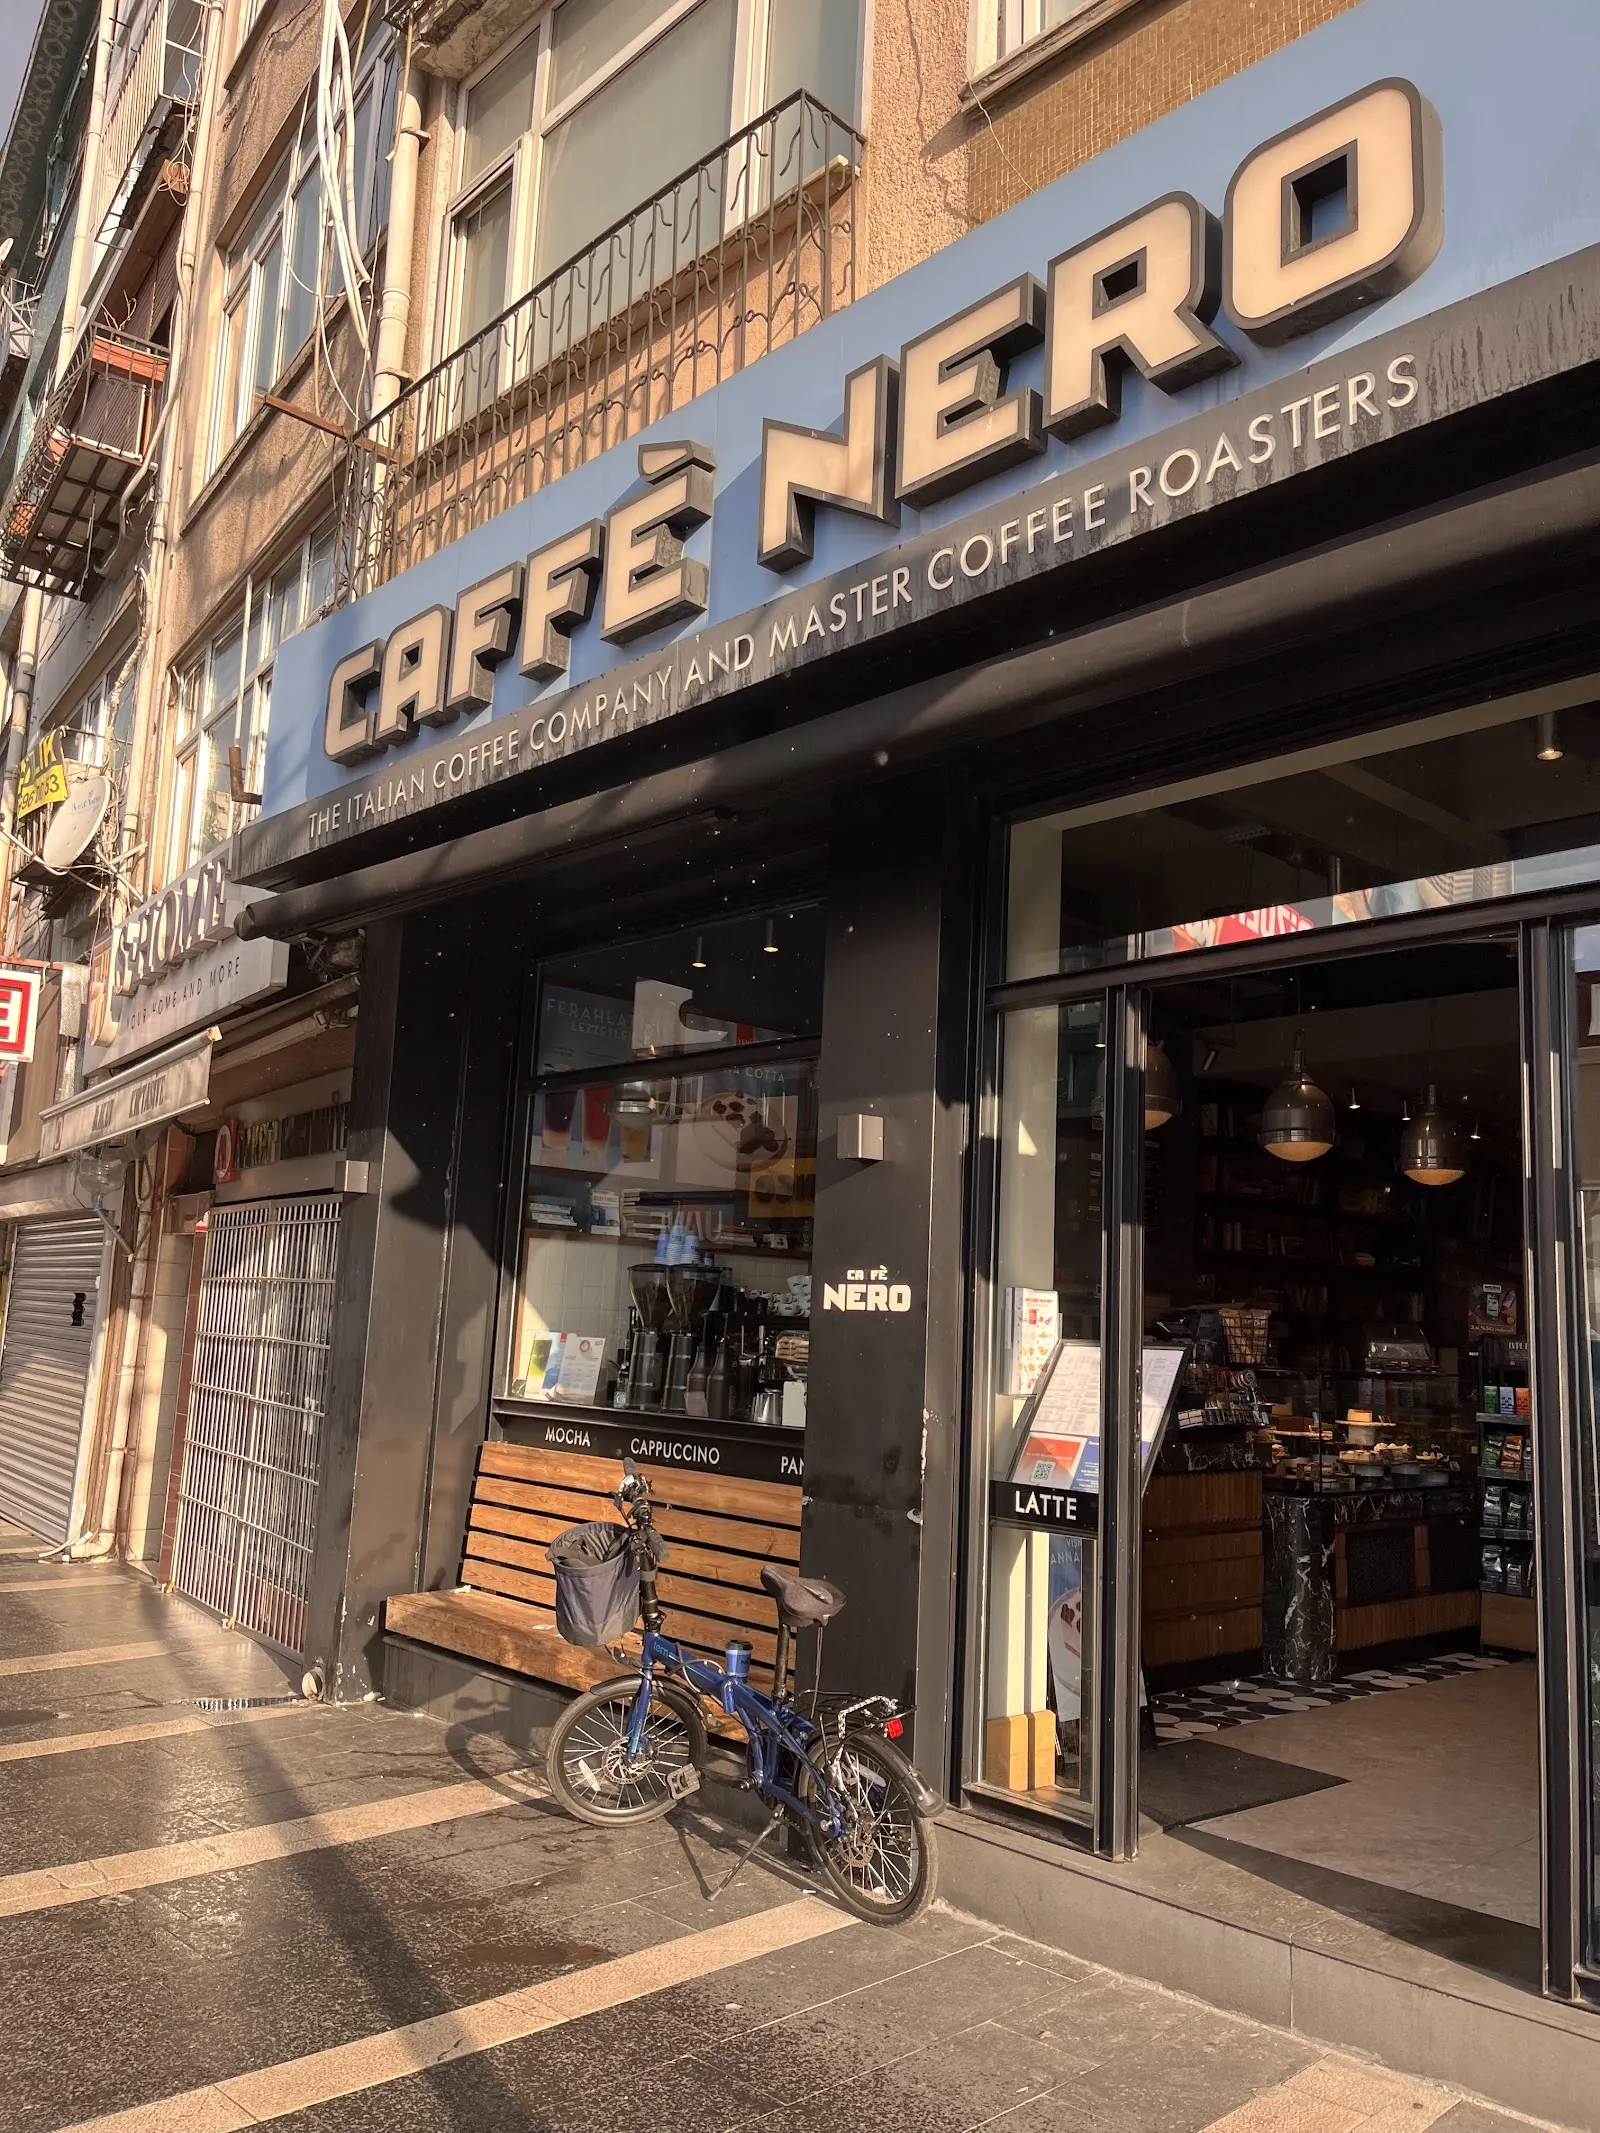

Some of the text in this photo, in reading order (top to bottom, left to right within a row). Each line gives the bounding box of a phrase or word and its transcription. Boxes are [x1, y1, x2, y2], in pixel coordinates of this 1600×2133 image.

[323, 77, 1443, 766] CAFFÈ NERO
[308, 353, 1421, 839] THE ITALIAN COFFEE COMPANY AND MASTER COFFEE ROASTERS
[182, 978, 203, 1003] AND
[210, 956, 241, 988] MORE
[545, 997, 634, 1028] FERAHLA
[745, 1066, 785, 1084] COTTA
[823, 1282, 912, 1313] NERO
[544, 1426, 592, 1448] MOCHA
[630, 1437, 721, 1466] CAPPUCCINO
[1014, 1490, 1078, 1521] LATTE
